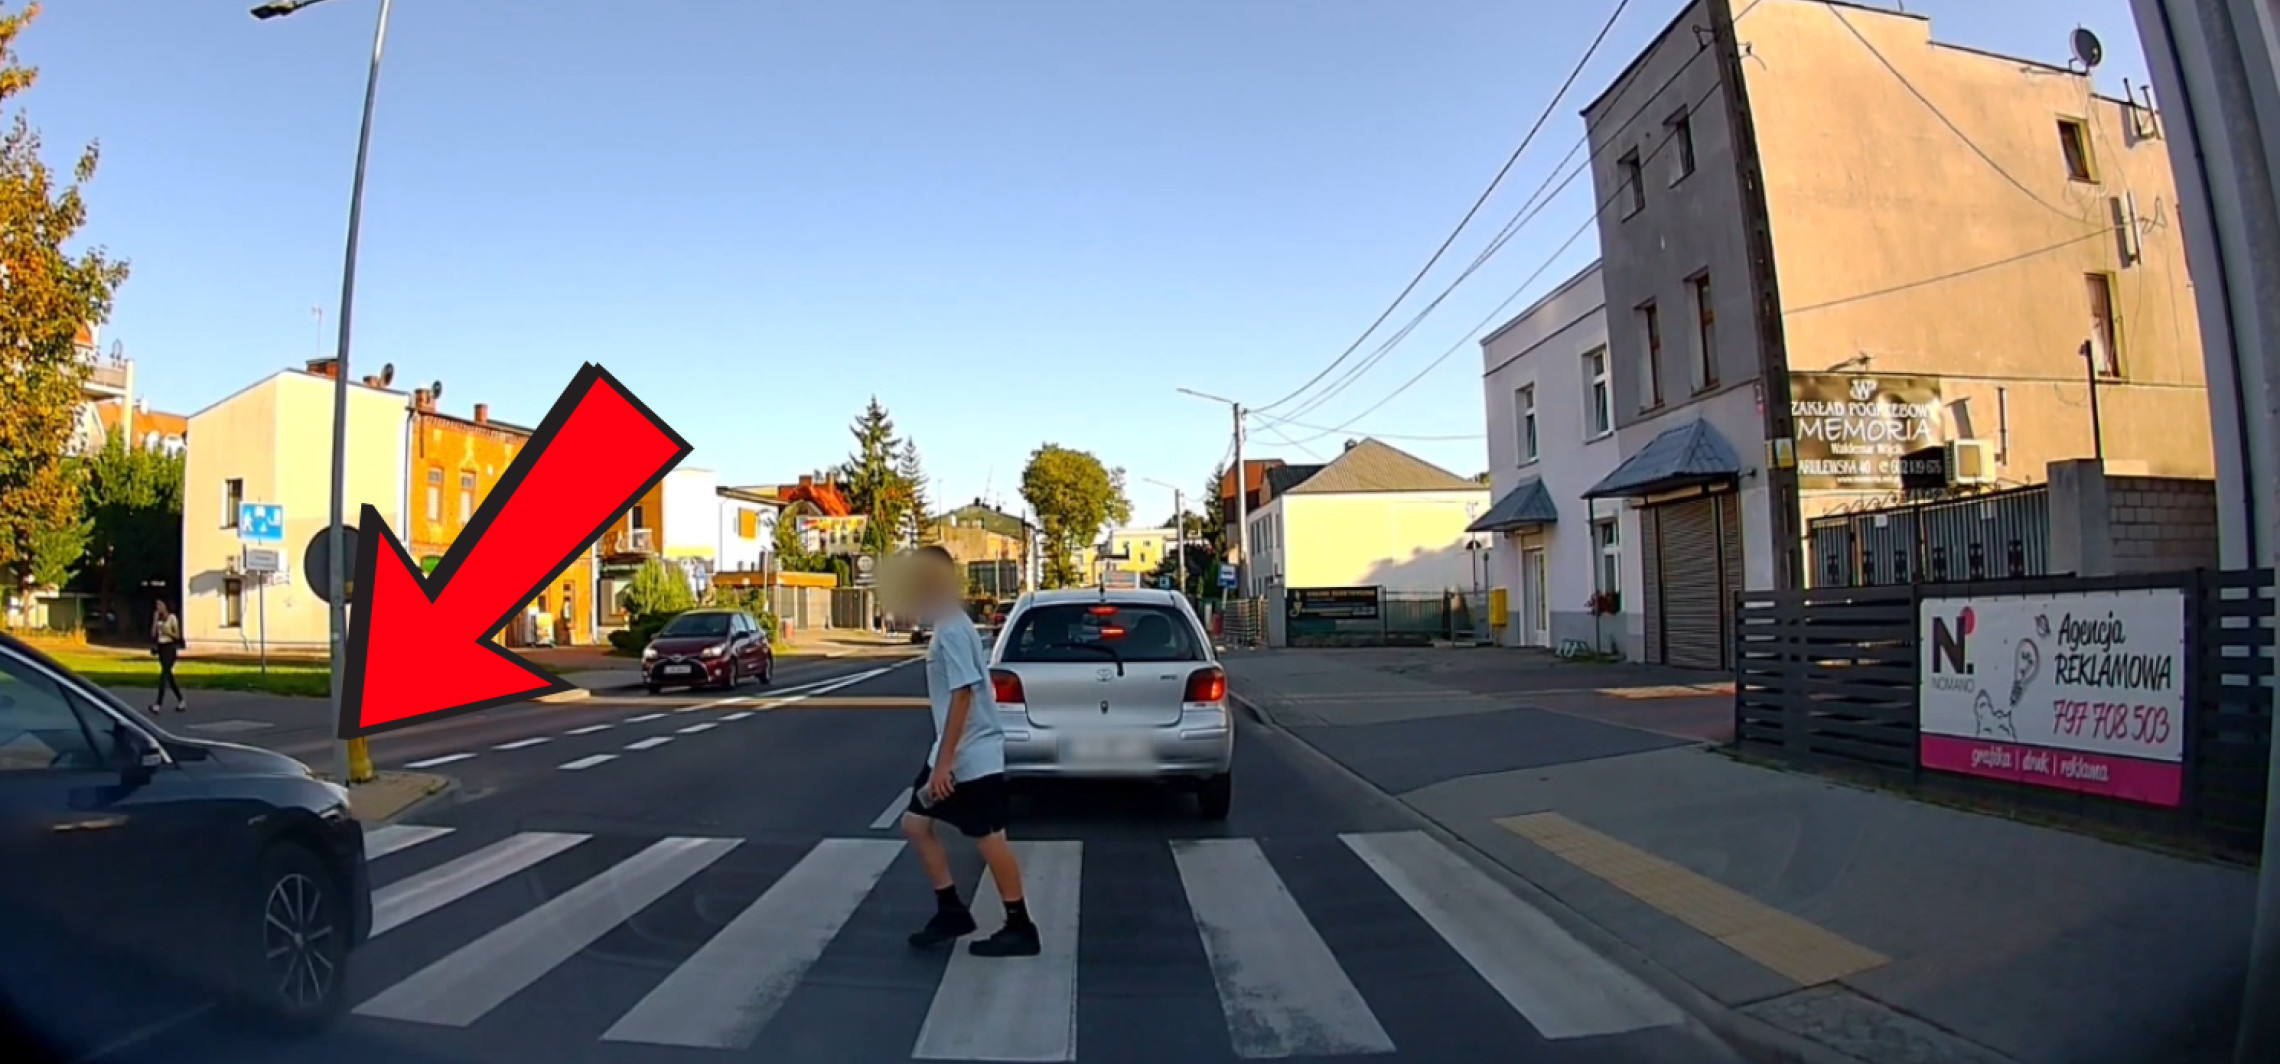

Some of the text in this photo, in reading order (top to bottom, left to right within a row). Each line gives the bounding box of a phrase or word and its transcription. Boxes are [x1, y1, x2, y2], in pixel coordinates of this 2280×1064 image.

[1791, 400, 1933, 418] ZAKŁAD POGREBOW
[1797, 418, 1929, 442] MEMORIA
[2058, 610, 2126, 652] Agencja
[2054, 653, 2172, 691] REKLAMOWA
[2053, 700, 2170, 744] 797 708 503
[1971, 745, 2109, 782] grafika druk reklama
